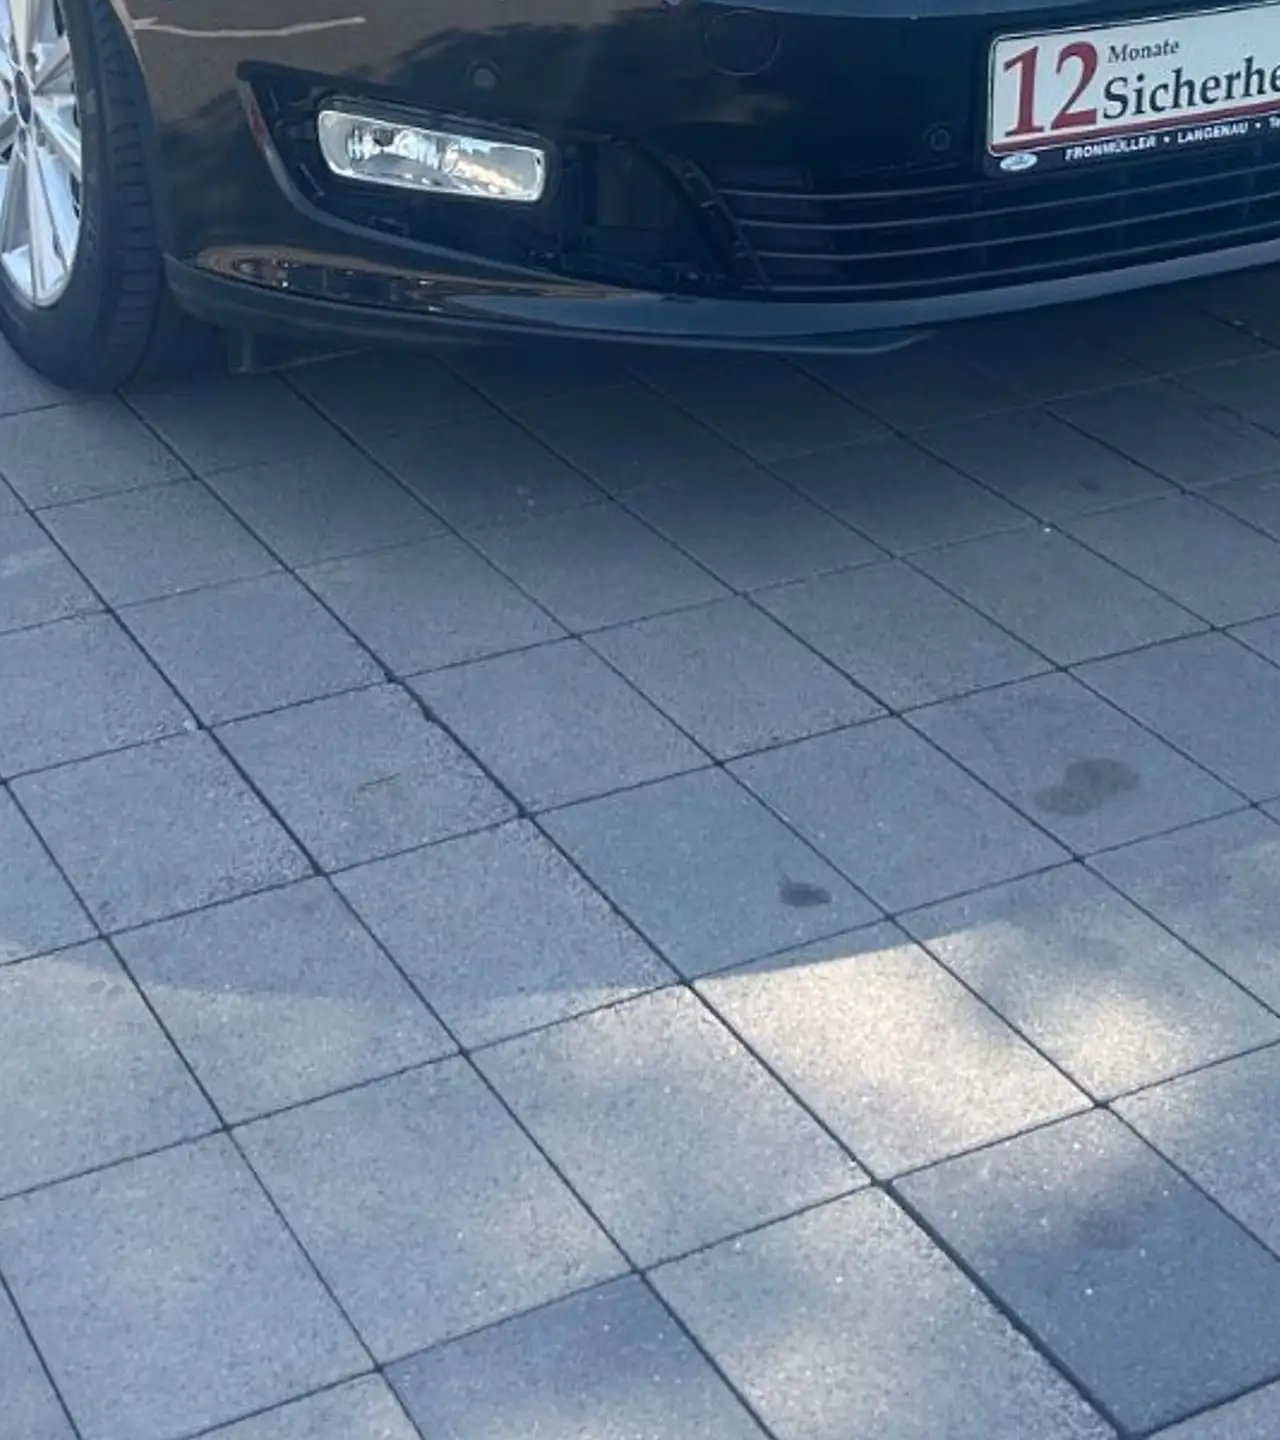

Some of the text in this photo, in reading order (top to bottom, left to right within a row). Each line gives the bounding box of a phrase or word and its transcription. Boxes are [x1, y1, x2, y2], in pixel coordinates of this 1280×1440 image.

[1002, 39, 1180, 138] 12 Monate
[1177, 120, 1250, 145] LANGENAU
